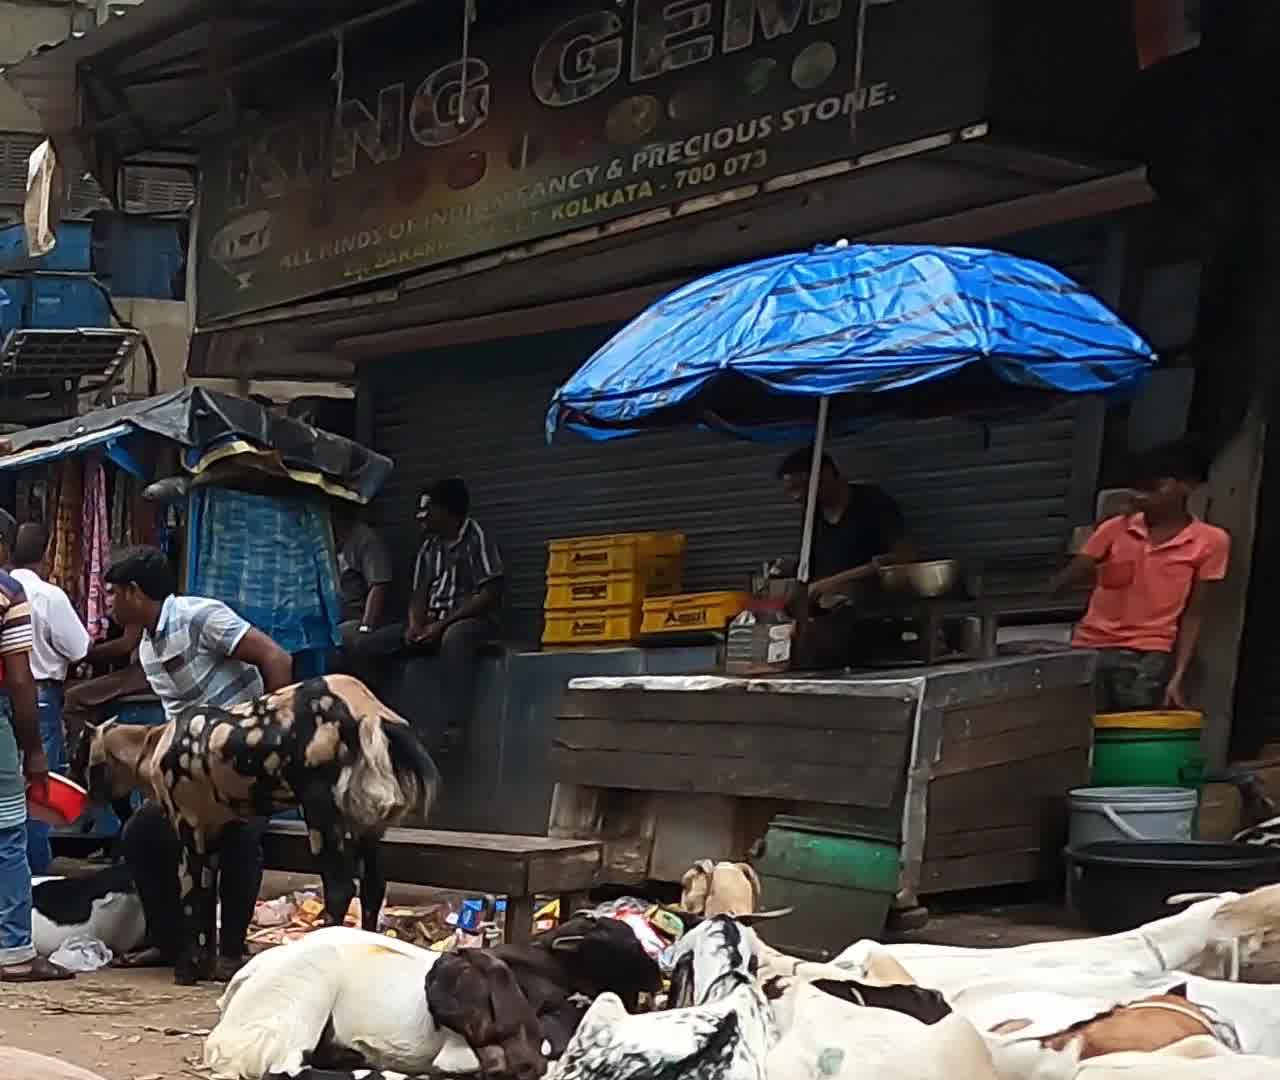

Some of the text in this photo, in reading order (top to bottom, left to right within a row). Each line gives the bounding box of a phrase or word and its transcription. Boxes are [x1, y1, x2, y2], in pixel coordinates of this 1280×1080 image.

[518, 162, 600, 208] FANCY
[605, 153, 625, 182] &
[631, 114, 773, 172] PRECIOUS
[780, 80, 898, 133] STONE.
[551, 179, 657, 222] KOLKATA
[674, 158, 719, 190] 700
[722, 148, 769, 178] 073
